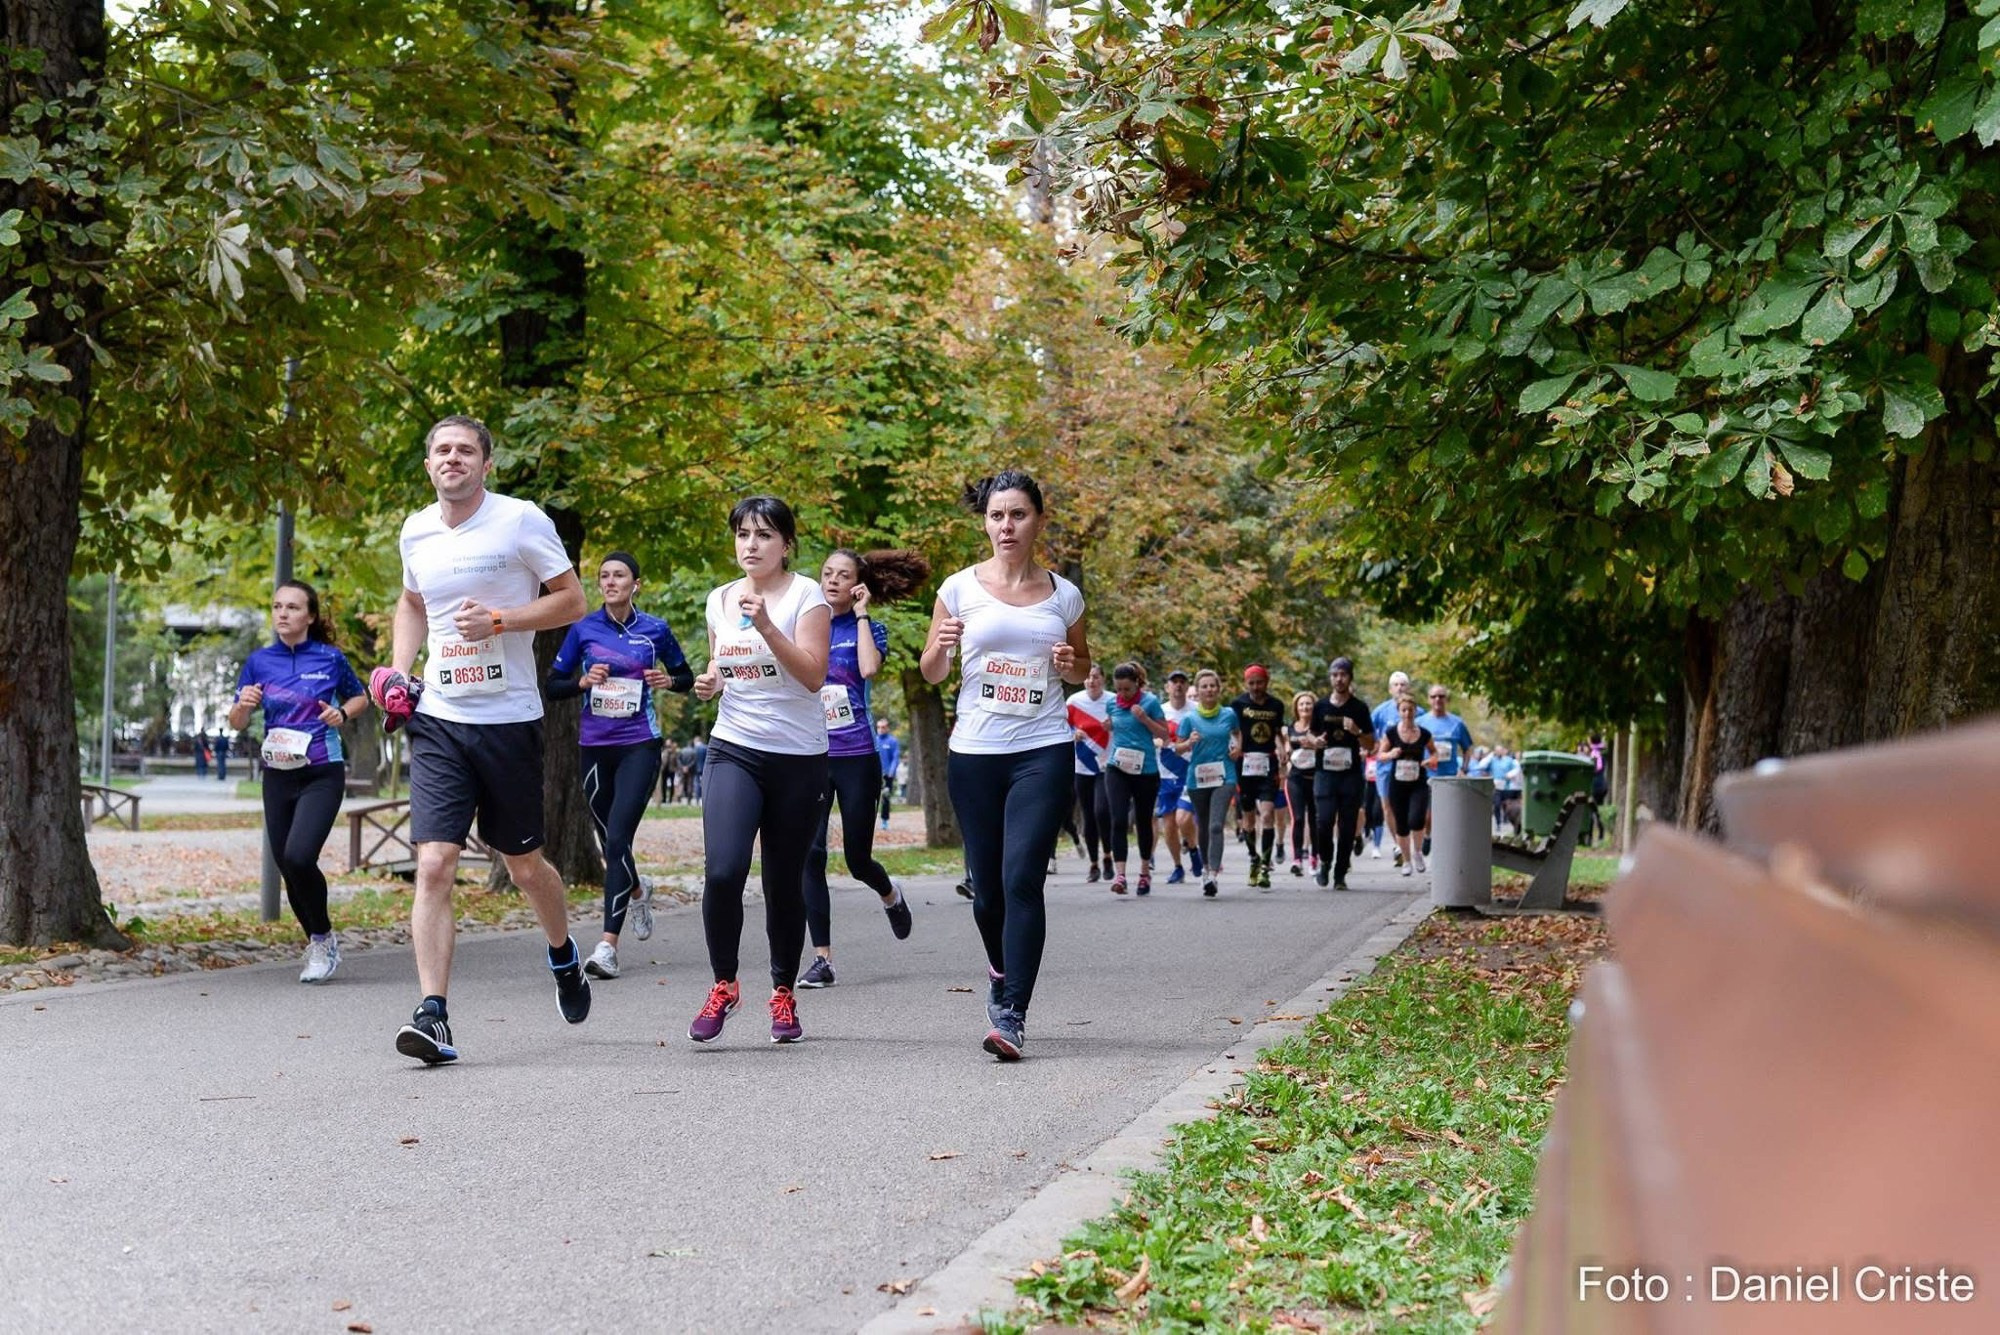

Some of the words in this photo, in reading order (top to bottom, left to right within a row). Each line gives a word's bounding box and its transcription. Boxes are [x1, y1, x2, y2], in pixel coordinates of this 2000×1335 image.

[454, 666, 485, 684] 8633
[733, 665, 761, 680] 8633
[996, 685, 1027, 704] 8633
